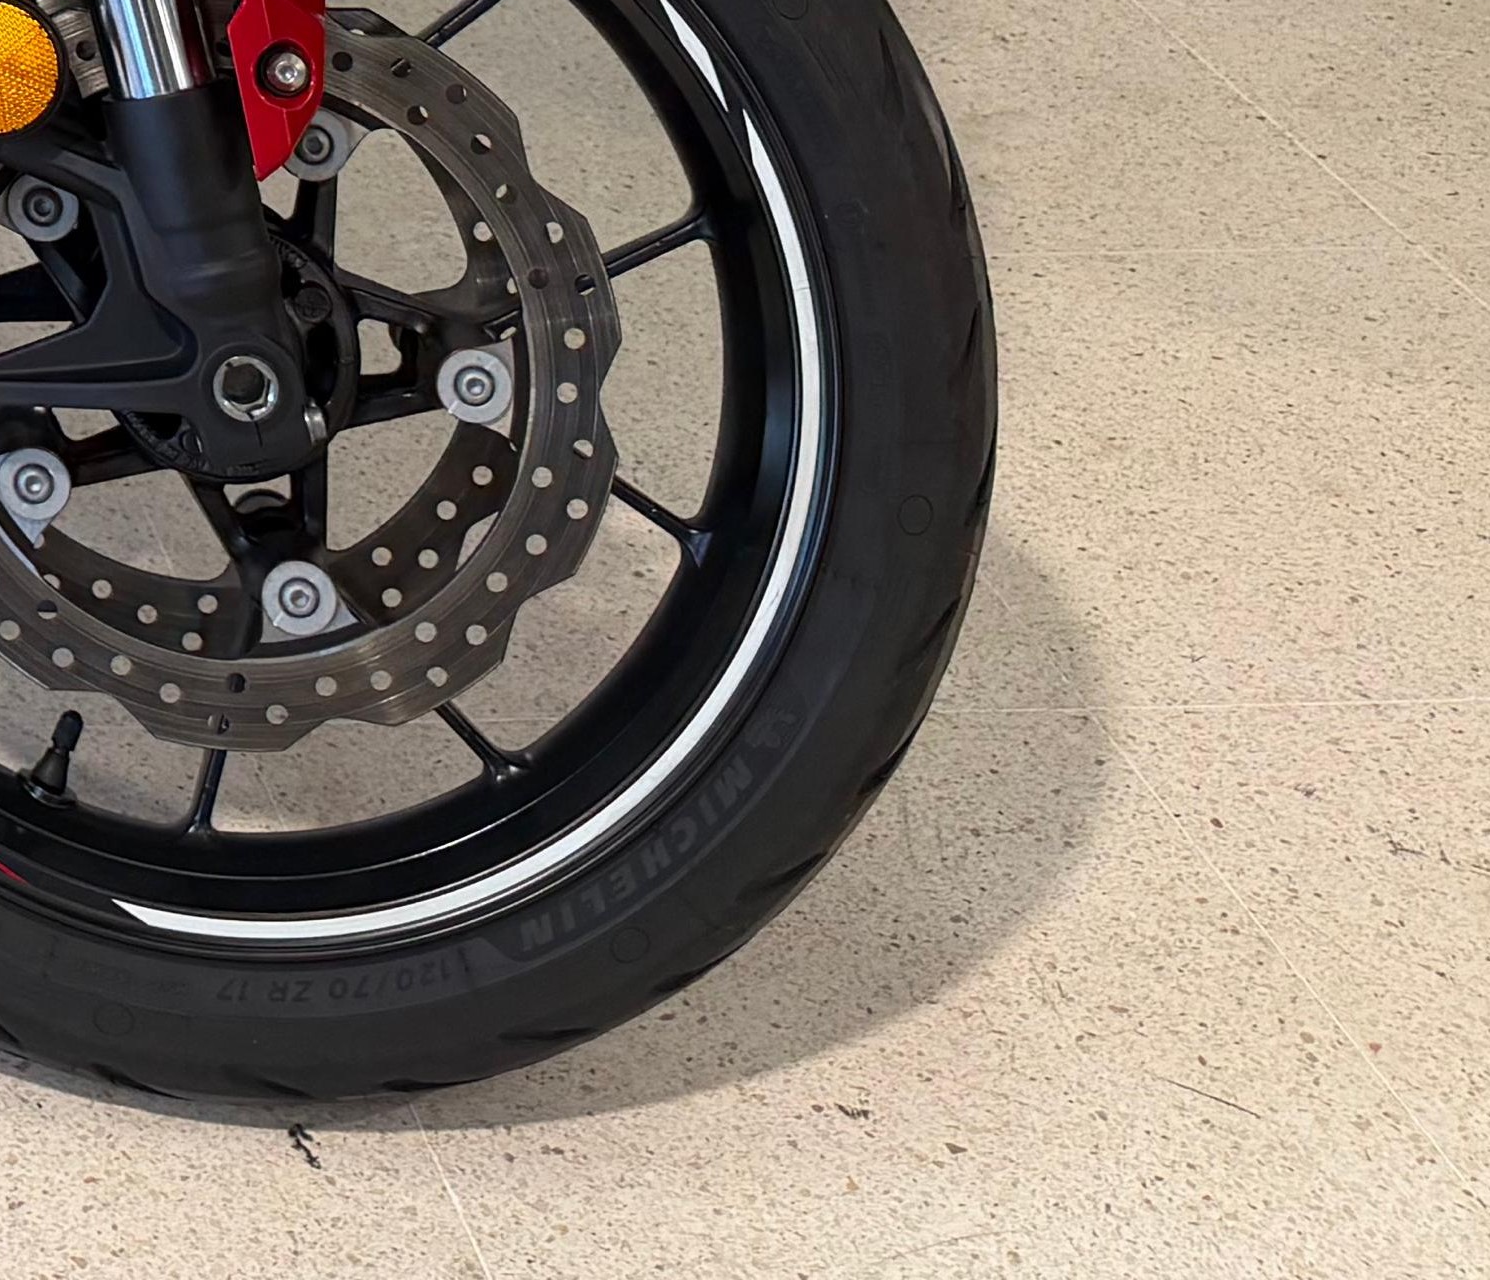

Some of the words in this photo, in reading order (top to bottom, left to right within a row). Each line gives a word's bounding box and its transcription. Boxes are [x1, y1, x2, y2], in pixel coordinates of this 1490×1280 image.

[518, 752, 758, 953] MICHELIN
[216, 976, 249, 1002] 17
[266, 978, 314, 1003] ZR
[326, 956, 451, 1001] 120/70
